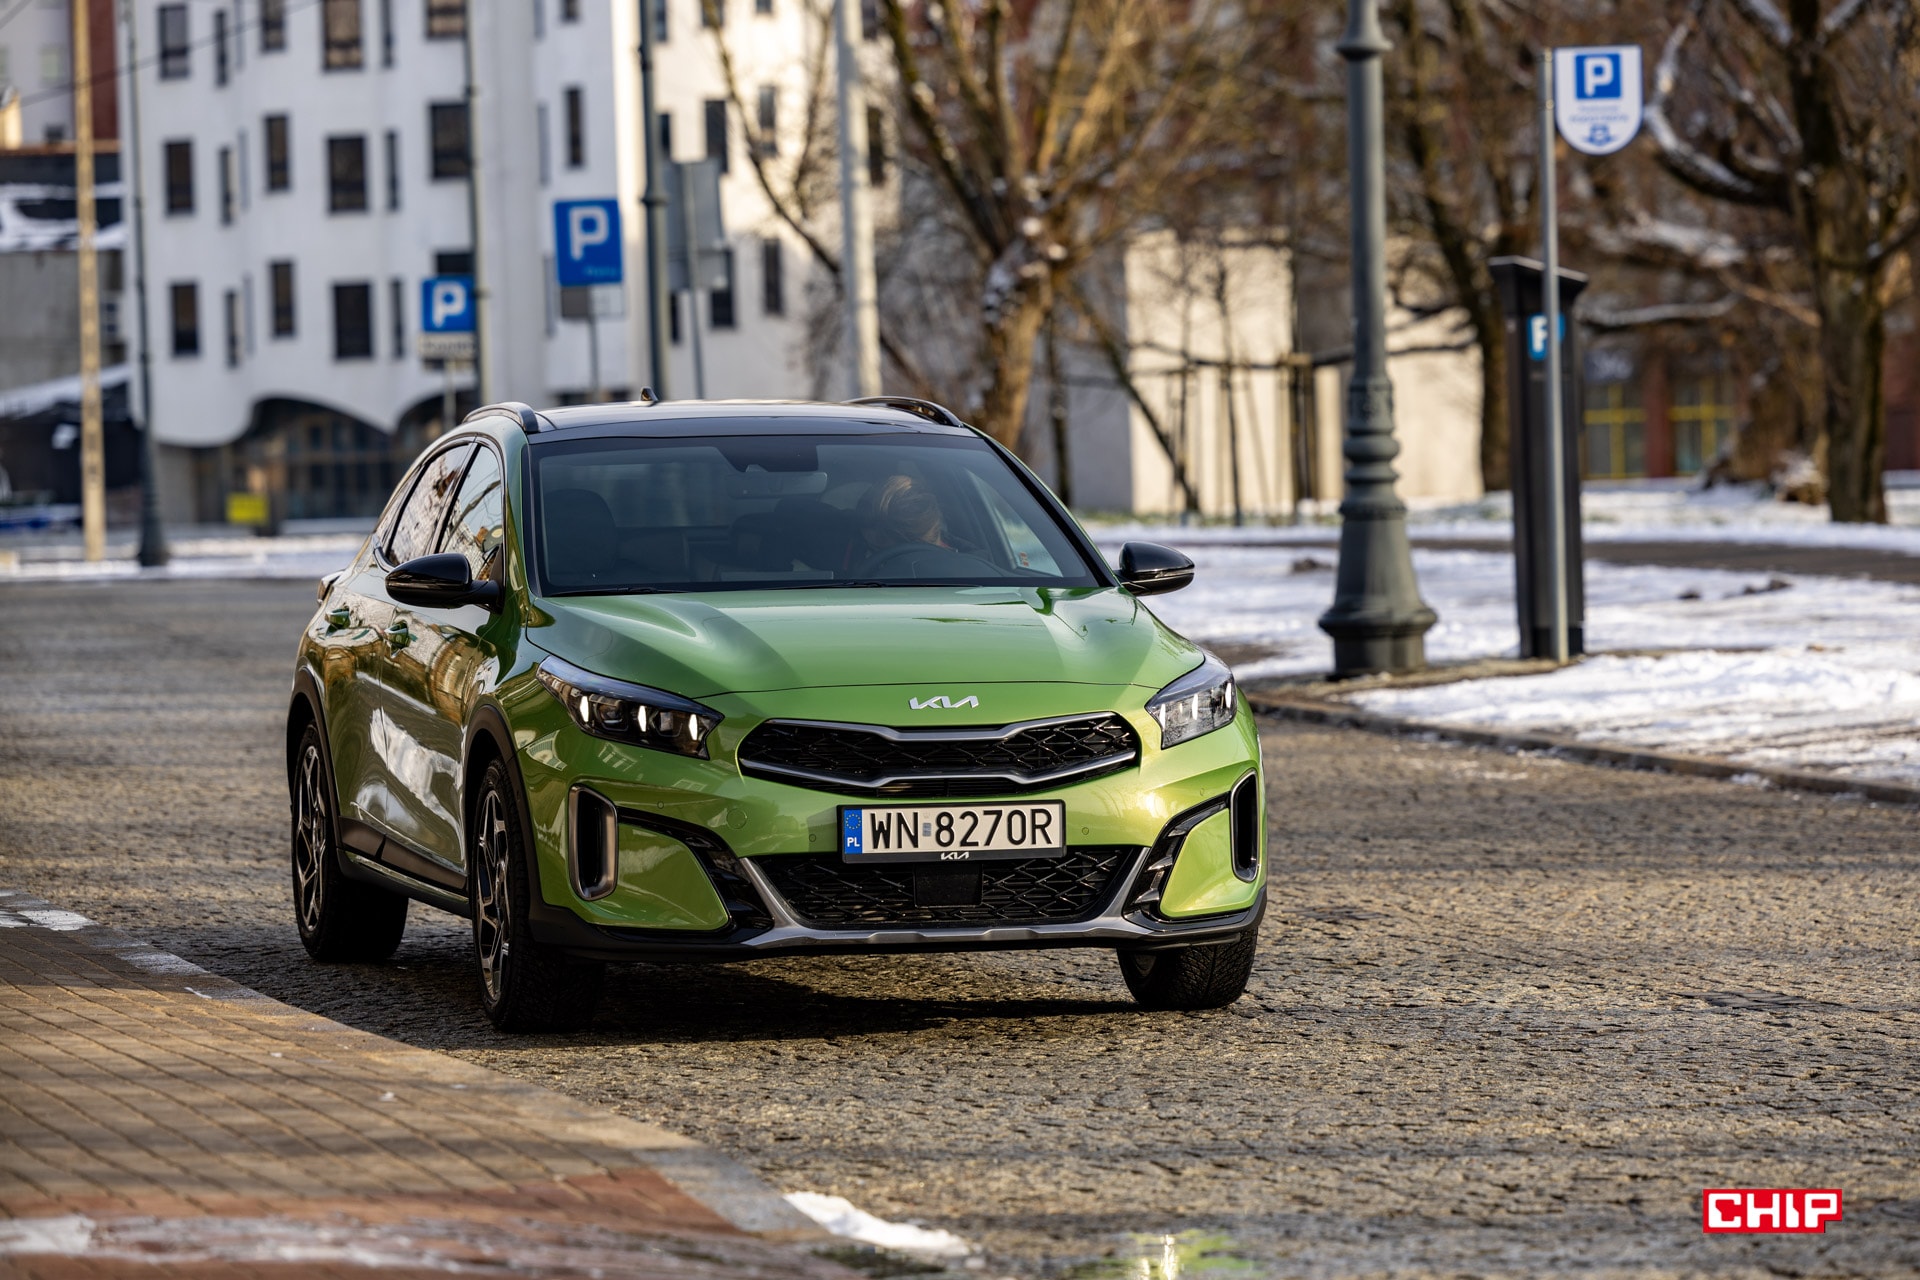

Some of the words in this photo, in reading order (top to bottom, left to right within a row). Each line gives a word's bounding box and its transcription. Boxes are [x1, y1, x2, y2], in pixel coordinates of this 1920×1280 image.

[1583, 57, 1614, 97] P
[569, 206, 609, 260] P
[432, 281, 466, 328] P
[909, 695, 979, 710] KIA
[847, 837, 861, 848] PL
[870, 811, 919, 849] WN
[935, 808, 1053, 847] 8270R
[940, 851, 970, 861] KIA
